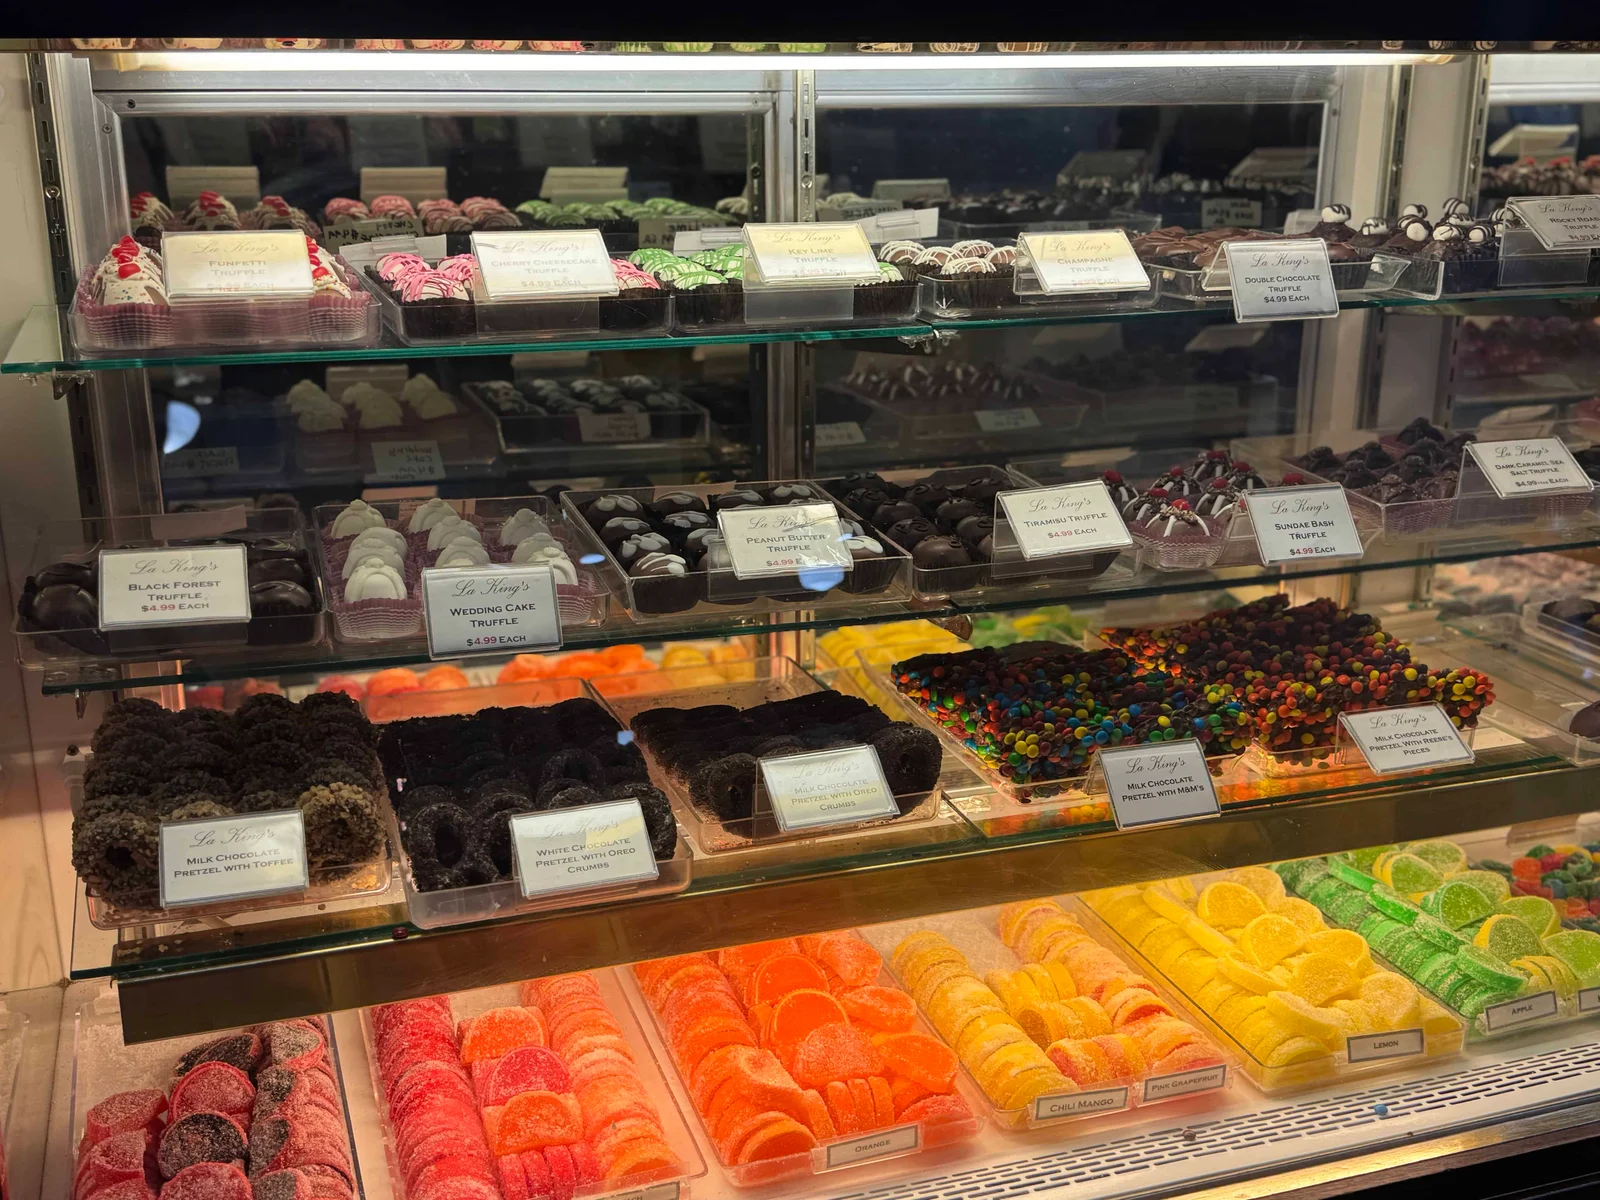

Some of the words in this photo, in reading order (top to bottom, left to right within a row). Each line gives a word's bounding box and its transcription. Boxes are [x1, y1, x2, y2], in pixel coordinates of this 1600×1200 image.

[1538, 203, 1555, 214] La
[1558, 202, 1593, 215] King's
[771, 231, 793, 244] La
[796, 230, 842, 245] King's
[192, 242, 220, 254] La
[224, 241, 280, 257] King's
[501, 240, 525, 254] La
[530, 240, 580, 257] King's
[1049, 240, 1068, 253] La
[1071, 238, 1112, 254] King's
[209, 260, 267, 268] FUNFETTI
[490, 260, 531, 268] CHERRY
[533, 258, 599, 266] CHEESECAKE
[792, 256, 838, 264] TRUFFLE
[1057, 256, 1115, 266] CHAMPAGNE
[1250, 252, 1269, 268] La
[1271, 252, 1311, 271] King's
[210, 269, 266, 277] TRUFFLE
[524, 267, 570, 275] TRUFFLE
[1069, 266, 1110, 274] TRUFFLE
[520, 280, 551, 288] $4.99
[553, 279, 582, 287] EACH
[1244, 276, 1276, 284] DOUBLE
[1276, 273, 1321, 283] CHOCOLATE
[1268, 285, 1302, 293] TRUFFLE
[1263, 295, 1287, 304] $4.99
[1288, 294, 1310, 302] EACH
[1494, 445, 1512, 459] La
[1514, 444, 1549, 459] King's
[1494, 463, 1516, 471] DARK
[1516, 461, 1549, 469] CARAMEL
[1510, 469, 1529, 477] SALT
[1529, 467, 1560, 475] TRUFFLE
[1028, 497, 1048, 513] La
[1051, 494, 1092, 511] King's
[1269, 499, 1289, 515] La
[1291, 497, 1330, 517] King's
[746, 515, 768, 530] La
[1023, 517, 1068, 529] TIRAMISU
[1067, 512, 1108, 523] TRUFFLE
[1274, 521, 1311, 531] SUNDAE
[1311, 519, 1335, 529] BASH
[746, 536, 787, 545] PEANUT
[787, 533, 826, 543] BUTTER
[1047, 530, 1073, 540] $4.99
[1073, 527, 1098, 536] EACH
[1288, 531, 1328, 541] TRUFFLE
[766, 544, 811, 553] TRUFFLE
[1289, 547, 1313, 557] $4.99
[1314, 545, 1336, 554] EACH
[129, 559, 157, 575] La
[162, 557, 219, 577] King's
[766, 558, 794, 567] $4.99
[128, 582, 171, 592] BLACK
[173, 579, 222, 590] FOREST
[451, 578, 477, 597] La
[480, 576, 532, 600] King's
[146, 592, 203, 602] TRUFFLE
[141, 603, 176, 613] $4.99
[178, 602, 210, 611] EACH
[449, 604, 504, 617] WEDDING
[505, 602, 537, 613] CAKE
[470, 617, 520, 629] TRUFFLE
[466, 635, 498, 648] $4.99
[498, 634, 527, 645] EACH
[1369, 714, 1389, 730] La
[1390, 711, 1428, 729] King's
[1374, 734, 1394, 743] MILK
[1394, 727, 1440, 741] CHOCOLATE
[1369, 742, 1403, 753] PRETZEL
[1402, 739, 1424, 748] WITH
[1423, 734, 1454, 746] REESE'S
[1403, 745, 1432, 757] PIECES
[791, 764, 813, 780] La
[817, 759, 861, 776] King's
[1125, 756, 1145, 775] La
[1147, 754, 1187, 775] King's
[794, 785, 817, 795] MILK
[816, 778, 869, 792] CHOCOLATE
[1127, 781, 1148, 792] MILK
[1147, 774, 1195, 788] CHOCOLATE
[790, 794, 830, 806] PRETZEL
[829, 790, 853, 801] WITH
[852, 786, 879, 797] OREO
[1121, 792, 1157, 803] PRETZEL
[1156, 788, 1178, 798] WITH
[819, 799, 857, 812] CRUMBS
[540, 822, 565, 841] La
[568, 816, 621, 838] King's
[188, 829, 217, 849] La
[220, 824, 276, 847] King's
[535, 845, 571, 857] WHITE
[570, 836, 633, 853] CHOCOLATE
[186, 855, 214, 866] MILK
[214, 848, 282, 863] CHOCOLATE
[535, 855, 581, 869] PRETZEL
[580, 849, 608, 862] WITH
[607, 846, 637, 858] OREO
[173, 867, 223, 879] PRETZEL
[223, 863, 252, 873] WITH
[252, 857, 295, 869] TOFFEE
[567, 861, 611, 874] CRUMBS
[1510, 1003, 1535, 1016] APPLE
[1373, 1040, 1400, 1050] LEMON
[1151, 1082, 1171, 1092] PINK
[1171, 1073, 1220, 1089] GRAPEFRUIT
[1049, 1101, 1077, 1114] CHILI
[1077, 1097, 1115, 1110] MANGO
[854, 1139, 892, 1153] ORANGE
